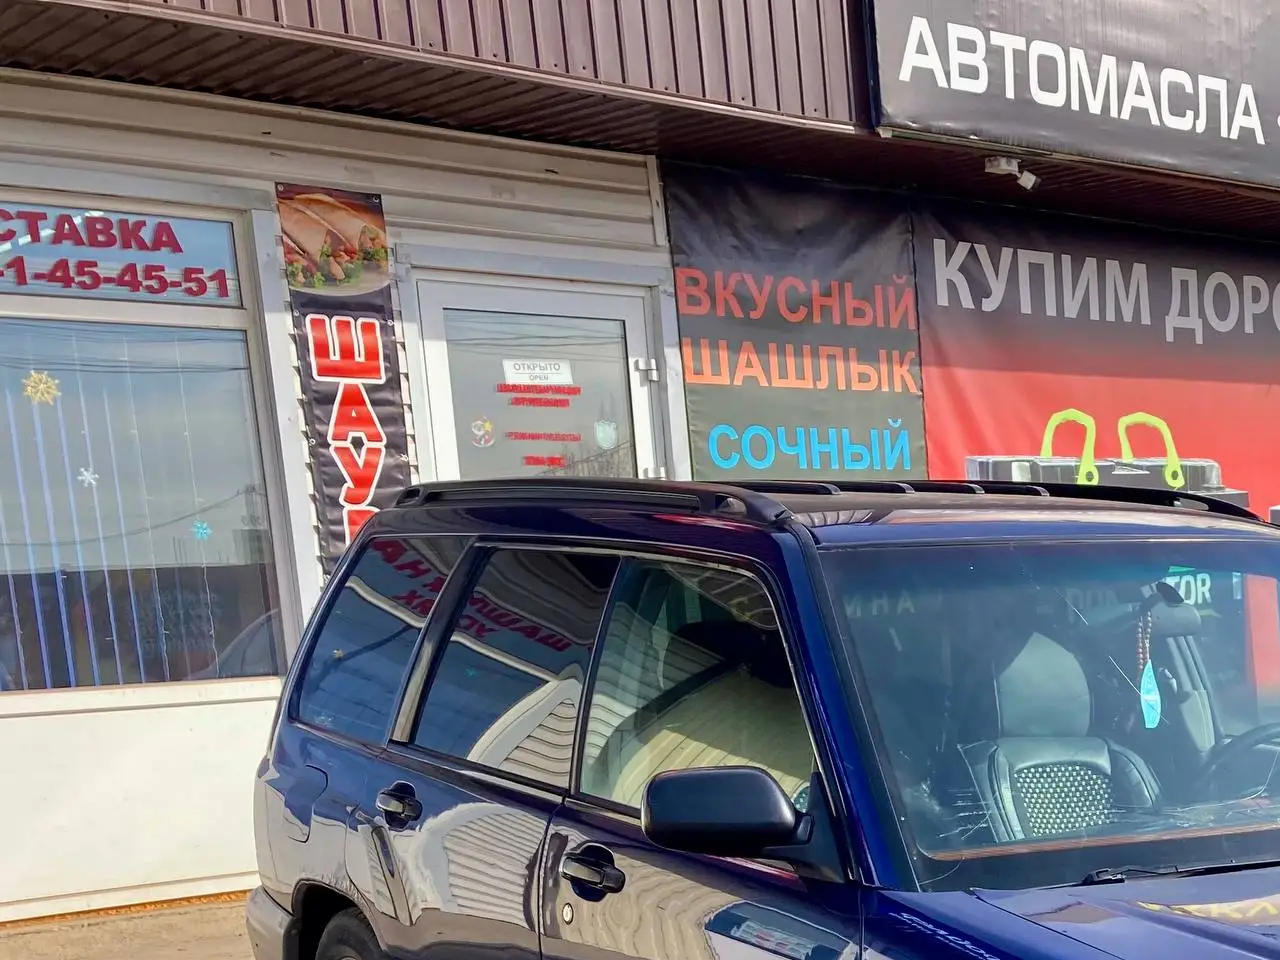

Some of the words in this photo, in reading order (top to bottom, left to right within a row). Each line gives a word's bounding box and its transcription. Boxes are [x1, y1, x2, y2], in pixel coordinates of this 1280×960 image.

[899, 16, 1265, 145] АВТОМАСЛА
[675, 267, 918, 331] ВКУСНЫЙ
[932, 238, 1152, 326] КУПИМ
[513, 362, 561, 372] ОТКРЫТО
[529, 374, 549, 382] OPEN
[682, 337, 920, 394] ШАШЛЫК
[708, 418, 912, 471] СОЧНЫЙ
